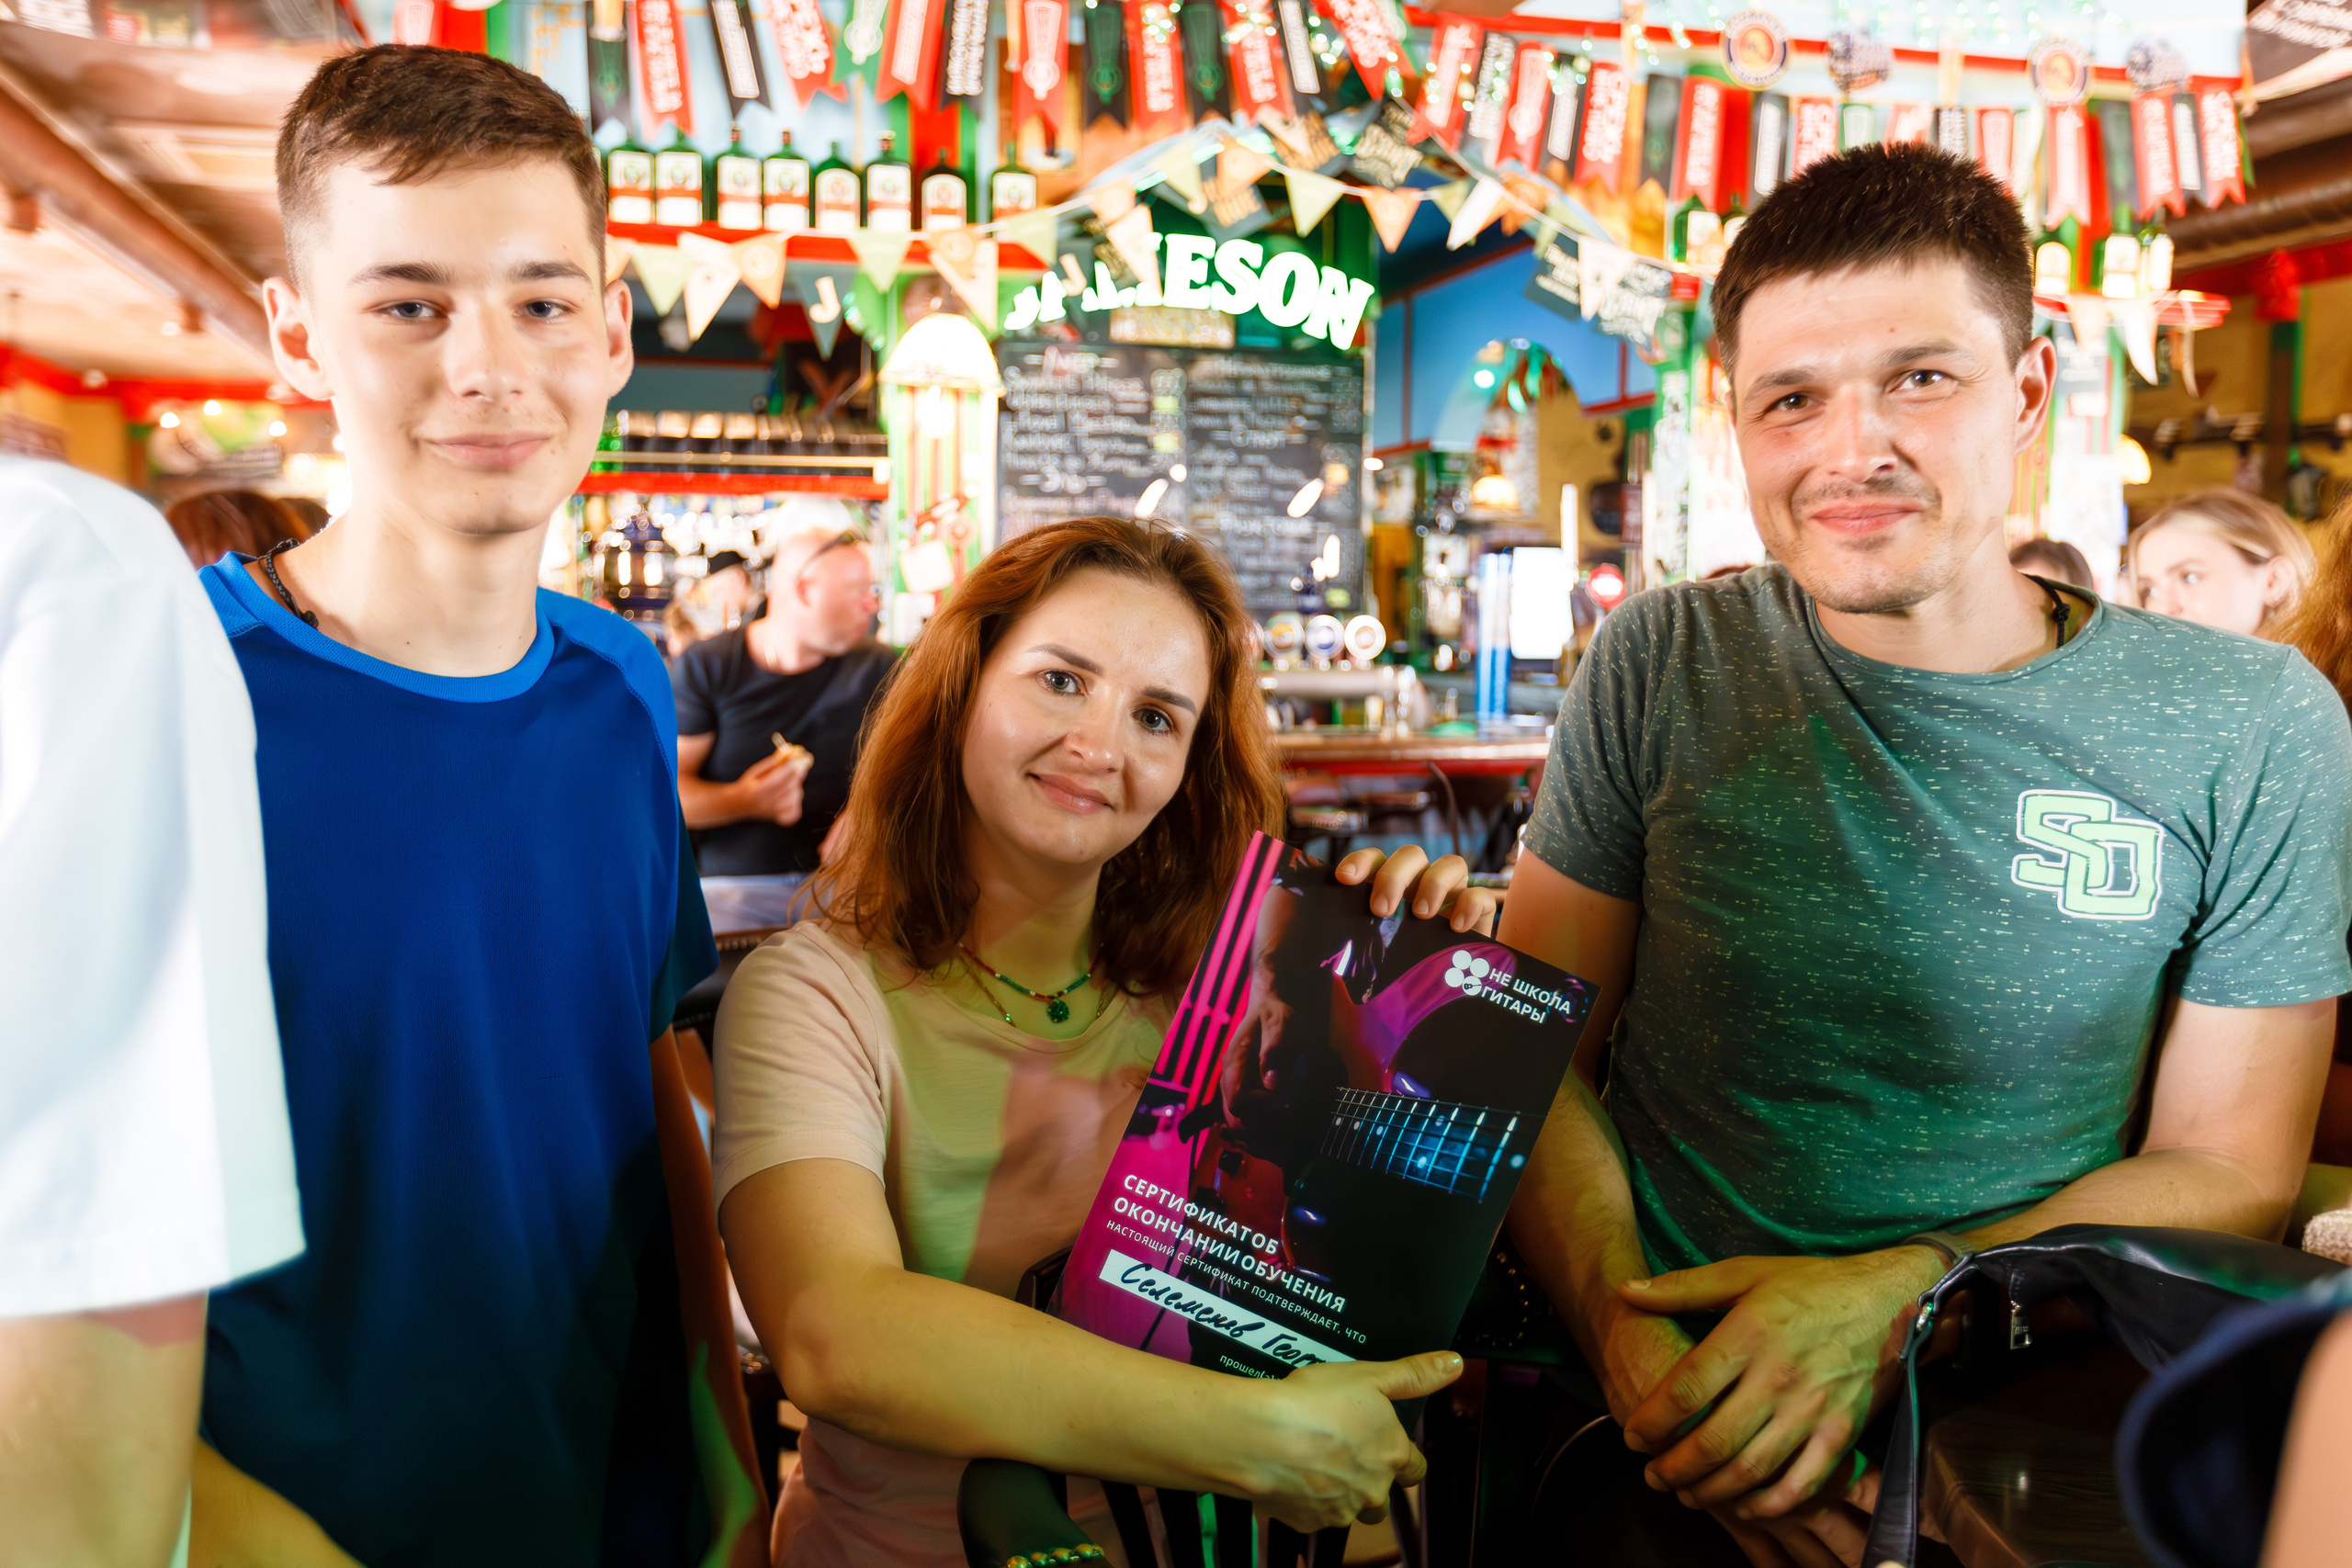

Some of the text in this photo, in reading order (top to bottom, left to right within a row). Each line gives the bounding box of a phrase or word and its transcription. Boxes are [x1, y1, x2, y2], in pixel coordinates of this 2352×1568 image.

[2010, 788, 2165, 921] SD
[1481, 986, 1547, 1024] ГИТАРЫ
[1488, 967, 1571, 1015] НЕ ШКОЛА
[1114, 1197, 1346, 1314] ОКОНЧАНИИ ОБУЧЕНИЯ
[1124, 1174, 1279, 1255] СЕРТИФИКАТ ОБ
[1106, 1219, 1367, 1344] НАСТОЯЩИЙ СЕРТИФИКАТ ПОДТВЕРЖДАЕТ, ЧТО
